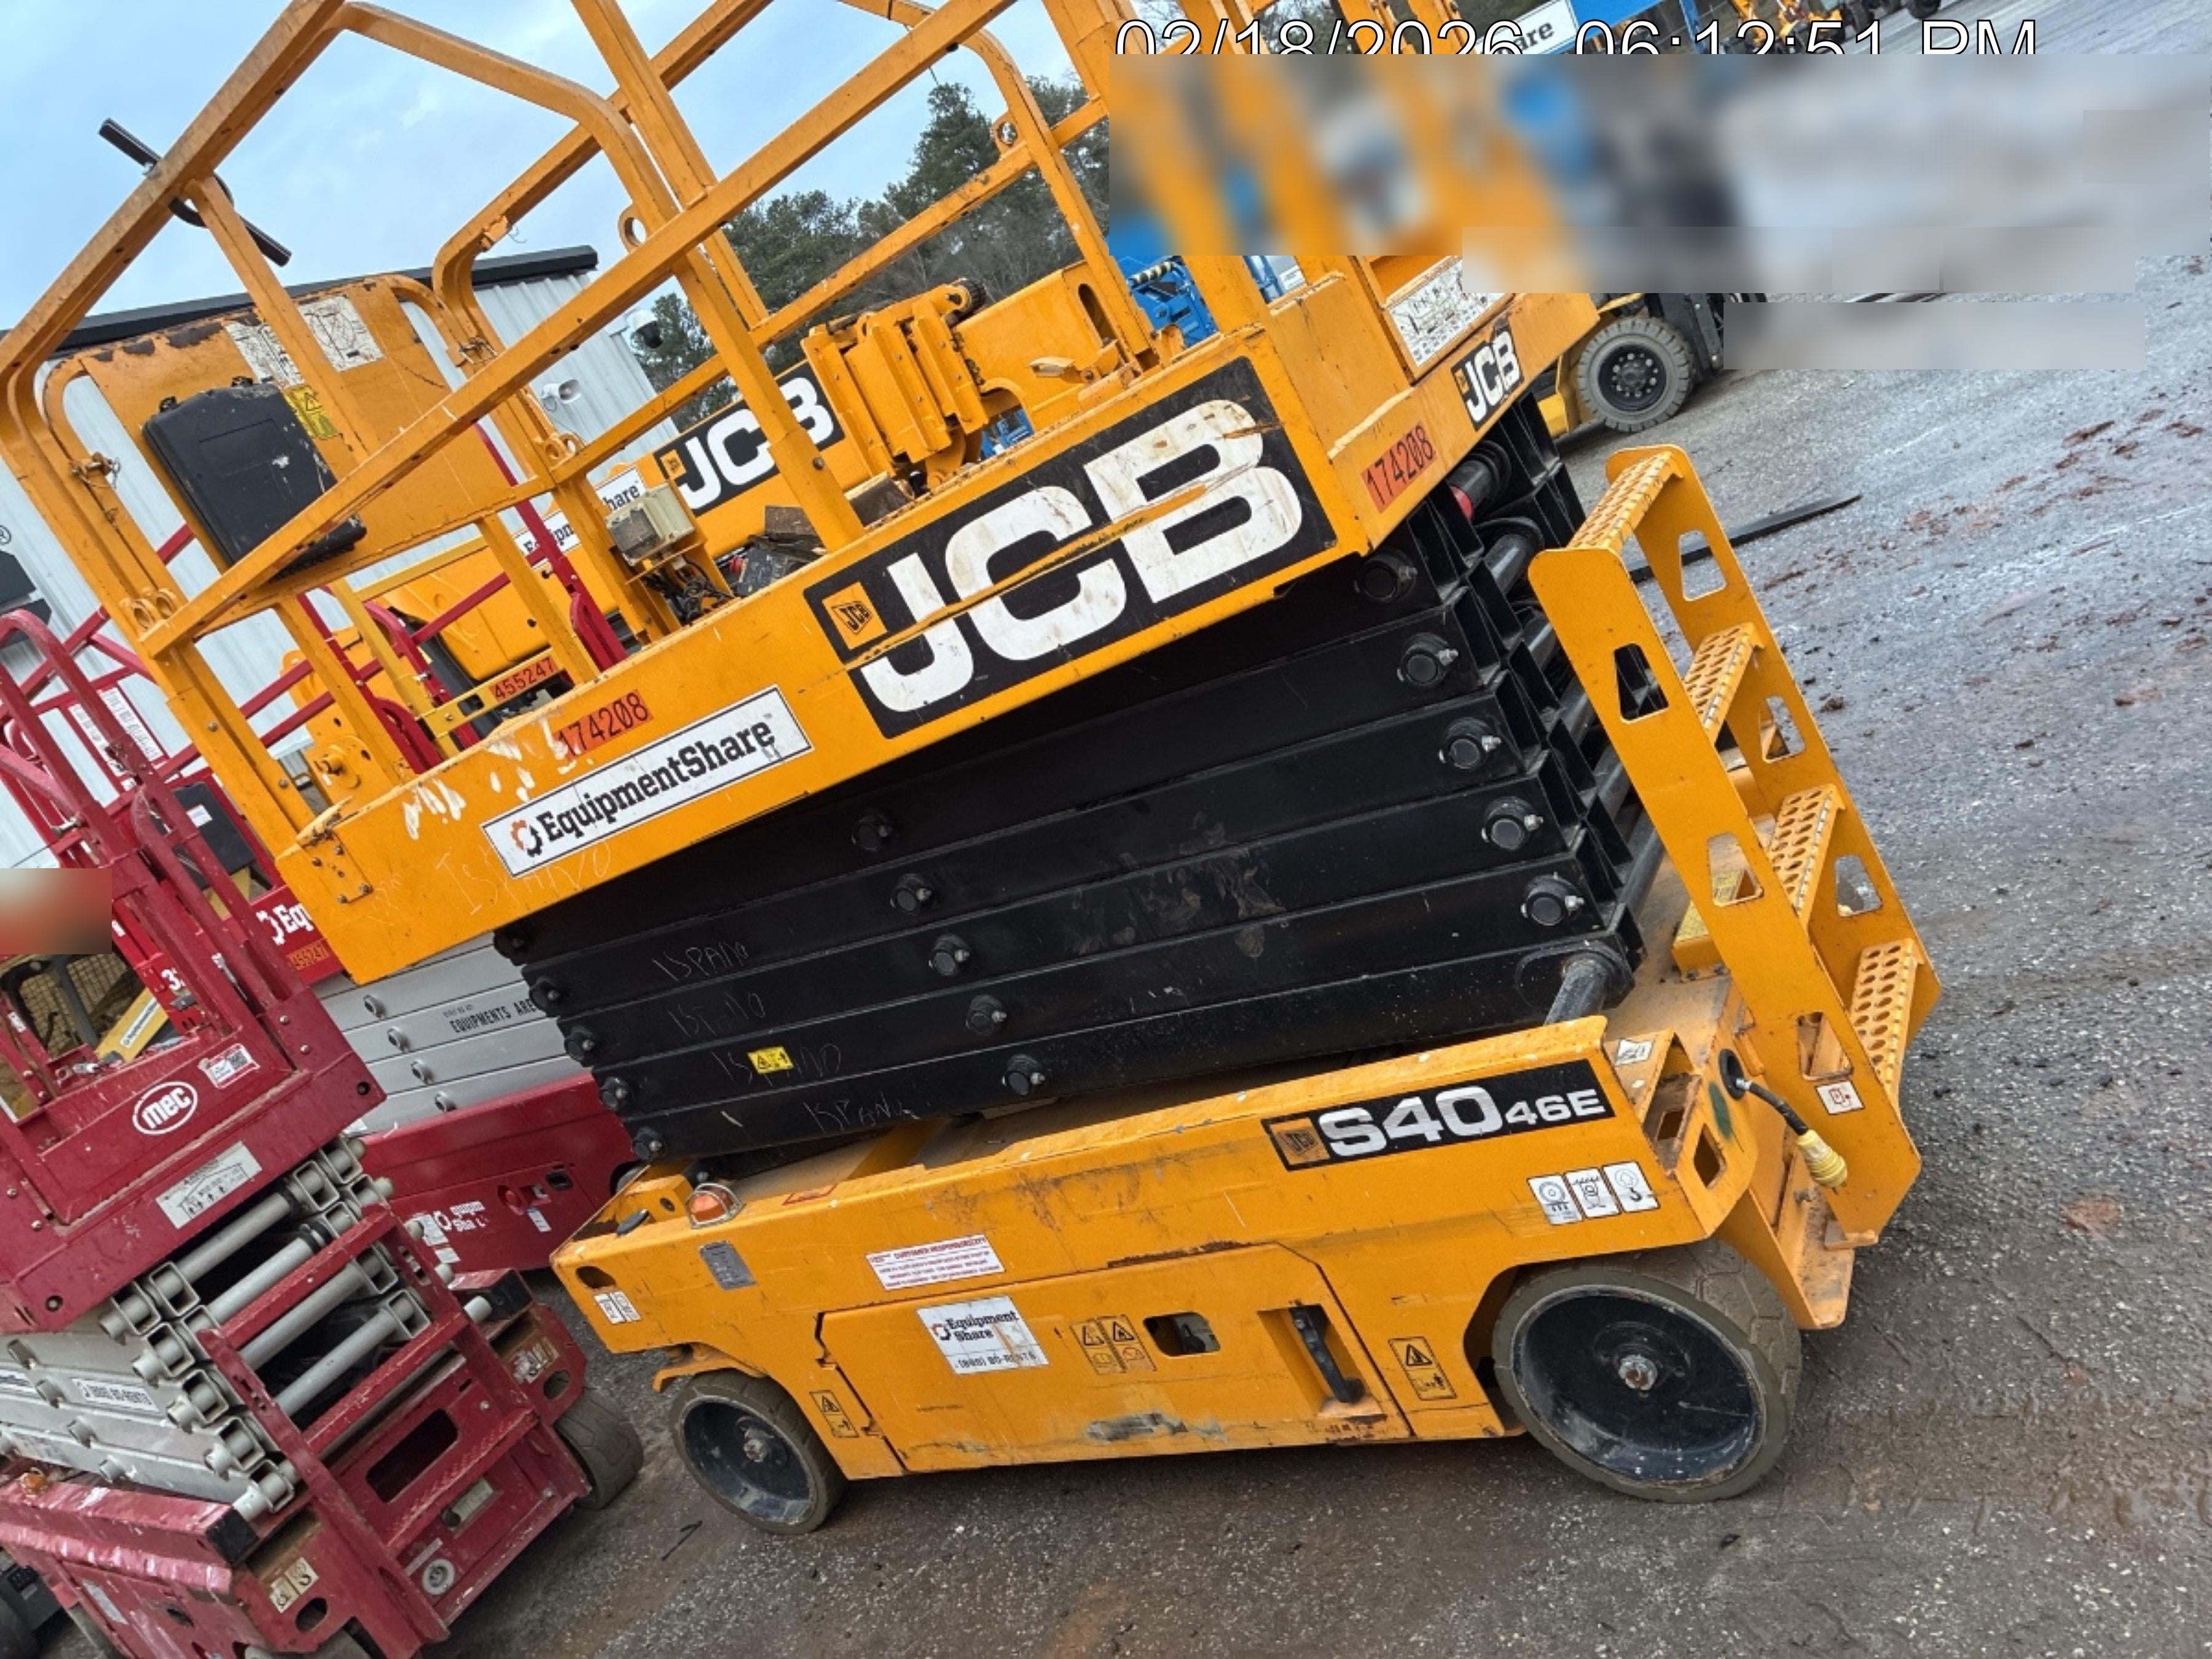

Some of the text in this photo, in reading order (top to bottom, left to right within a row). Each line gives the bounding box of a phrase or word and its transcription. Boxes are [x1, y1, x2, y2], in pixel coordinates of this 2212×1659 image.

[1464, 331, 1520, 422] JCB
[678, 377, 834, 509] JCB
[1367, 425, 1433, 505] 174208
[861, 399, 1302, 712] JCB
[495, 657, 554, 699] 455247
[558, 692, 648, 756] 174208
[536, 721, 776, 842] EquipmentShare
[1319, 1085, 1606, 1157] S40 46E
[946, 1311, 1019, 1330] Equipment
[953, 1328, 994, 1343] Share
